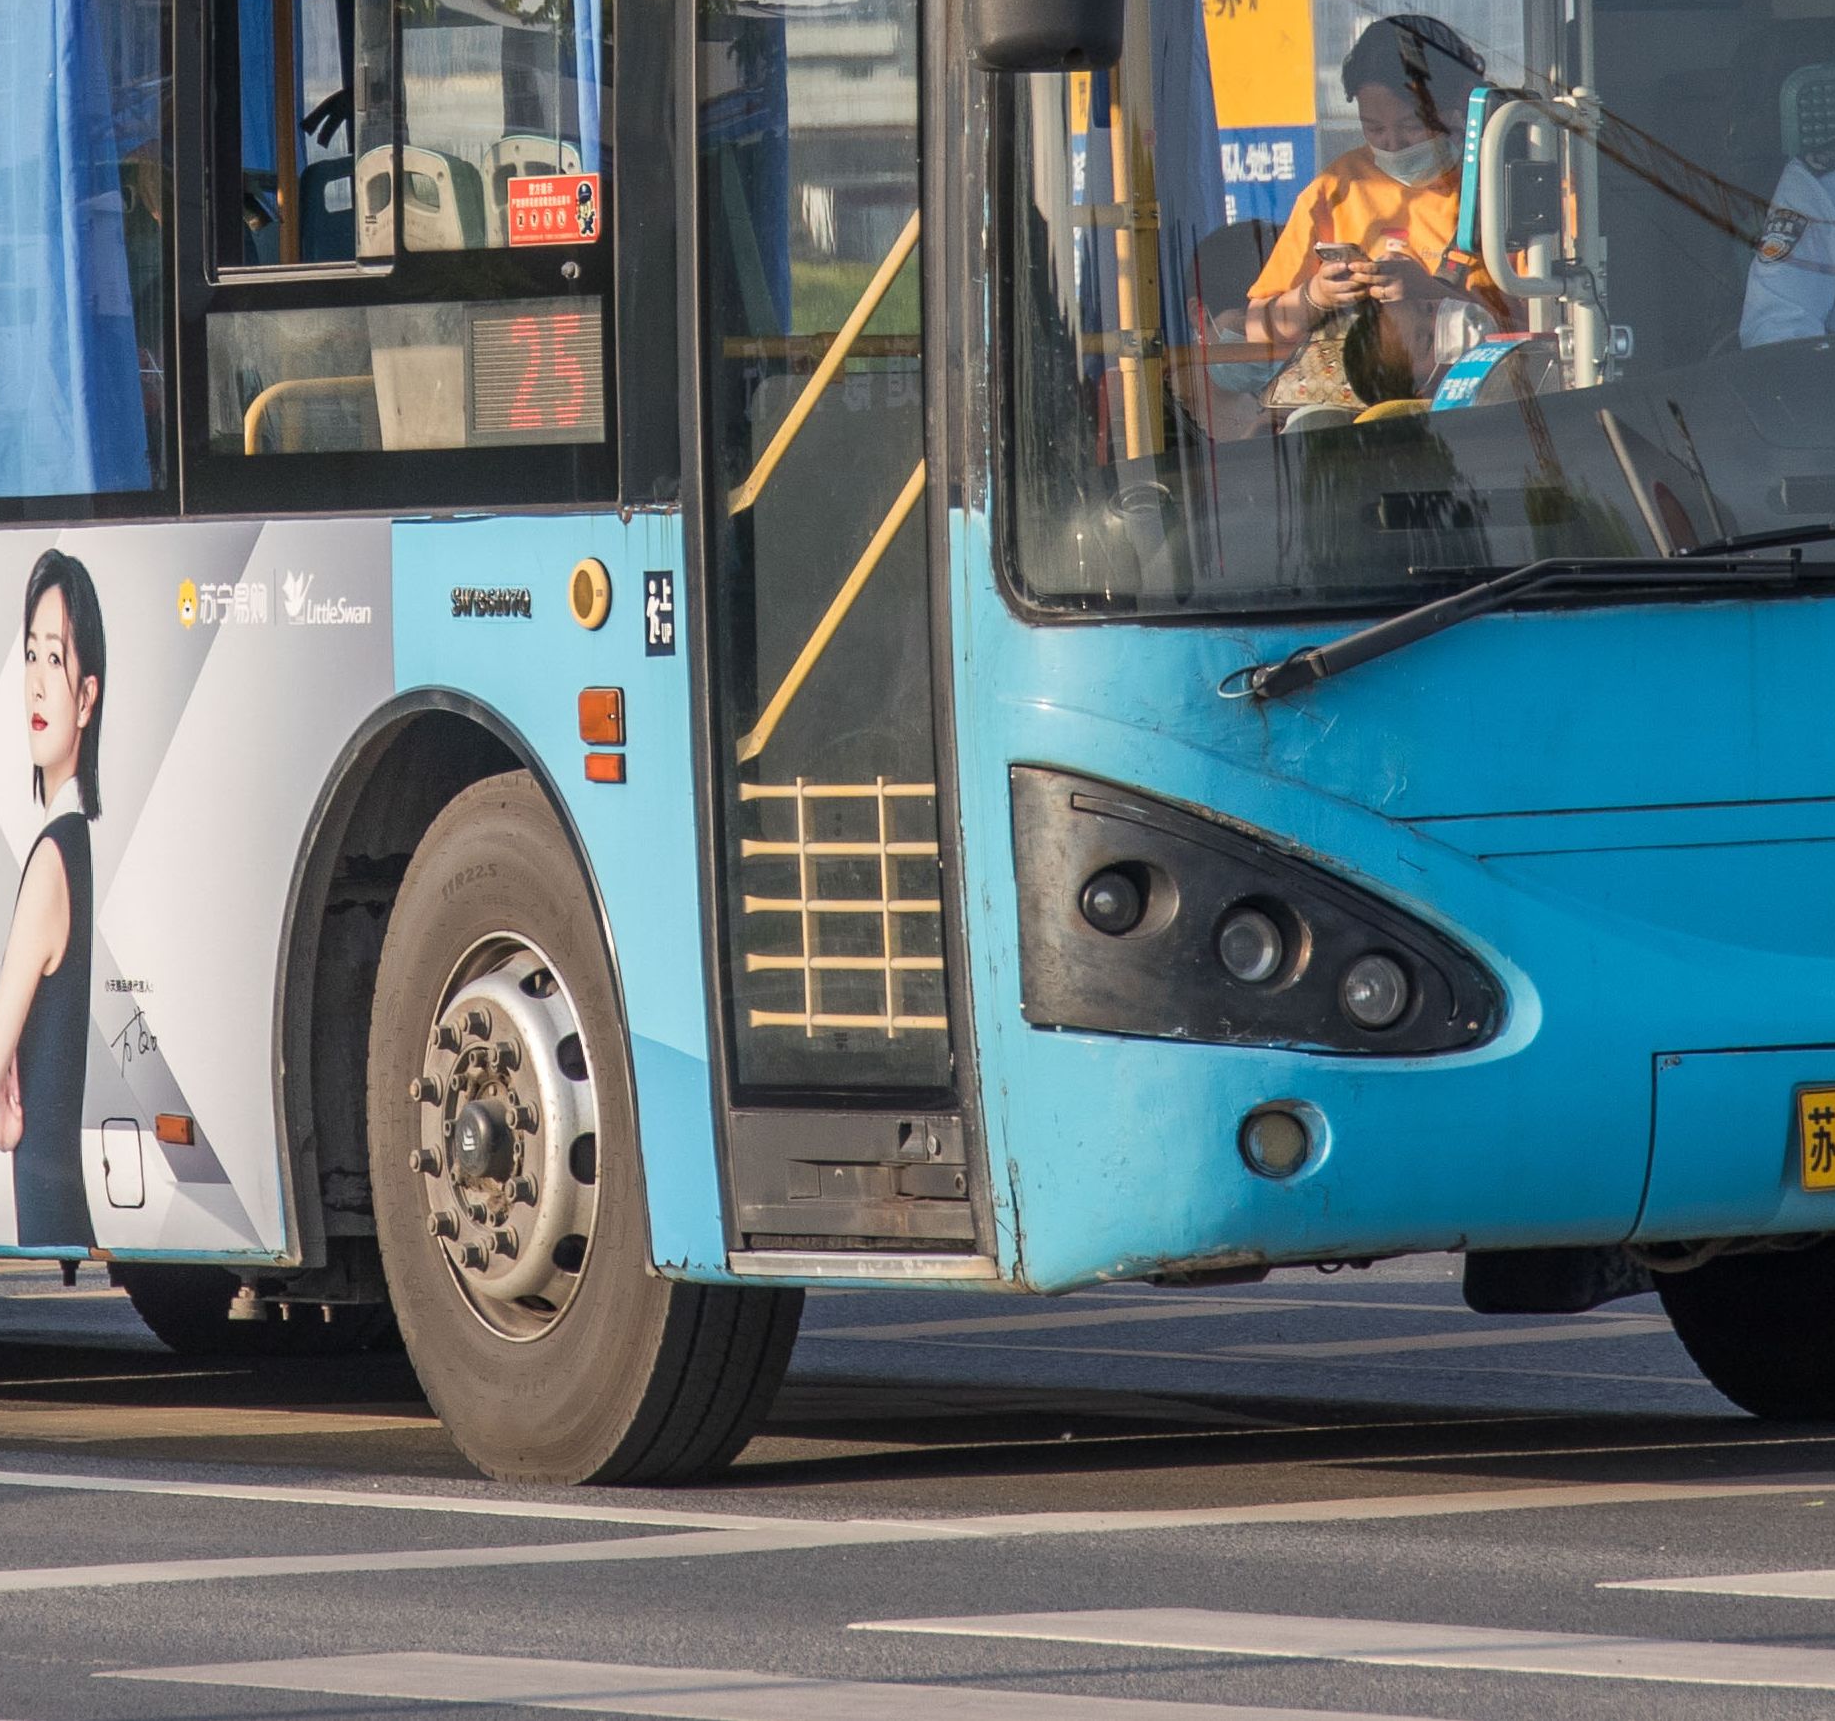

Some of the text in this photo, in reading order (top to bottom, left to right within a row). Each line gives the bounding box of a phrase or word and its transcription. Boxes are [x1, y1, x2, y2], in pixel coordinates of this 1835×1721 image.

[508, 314, 585, 430] 25
[199, 582, 268, 625] 苏宁易购
[661, 622, 673, 645] UP
